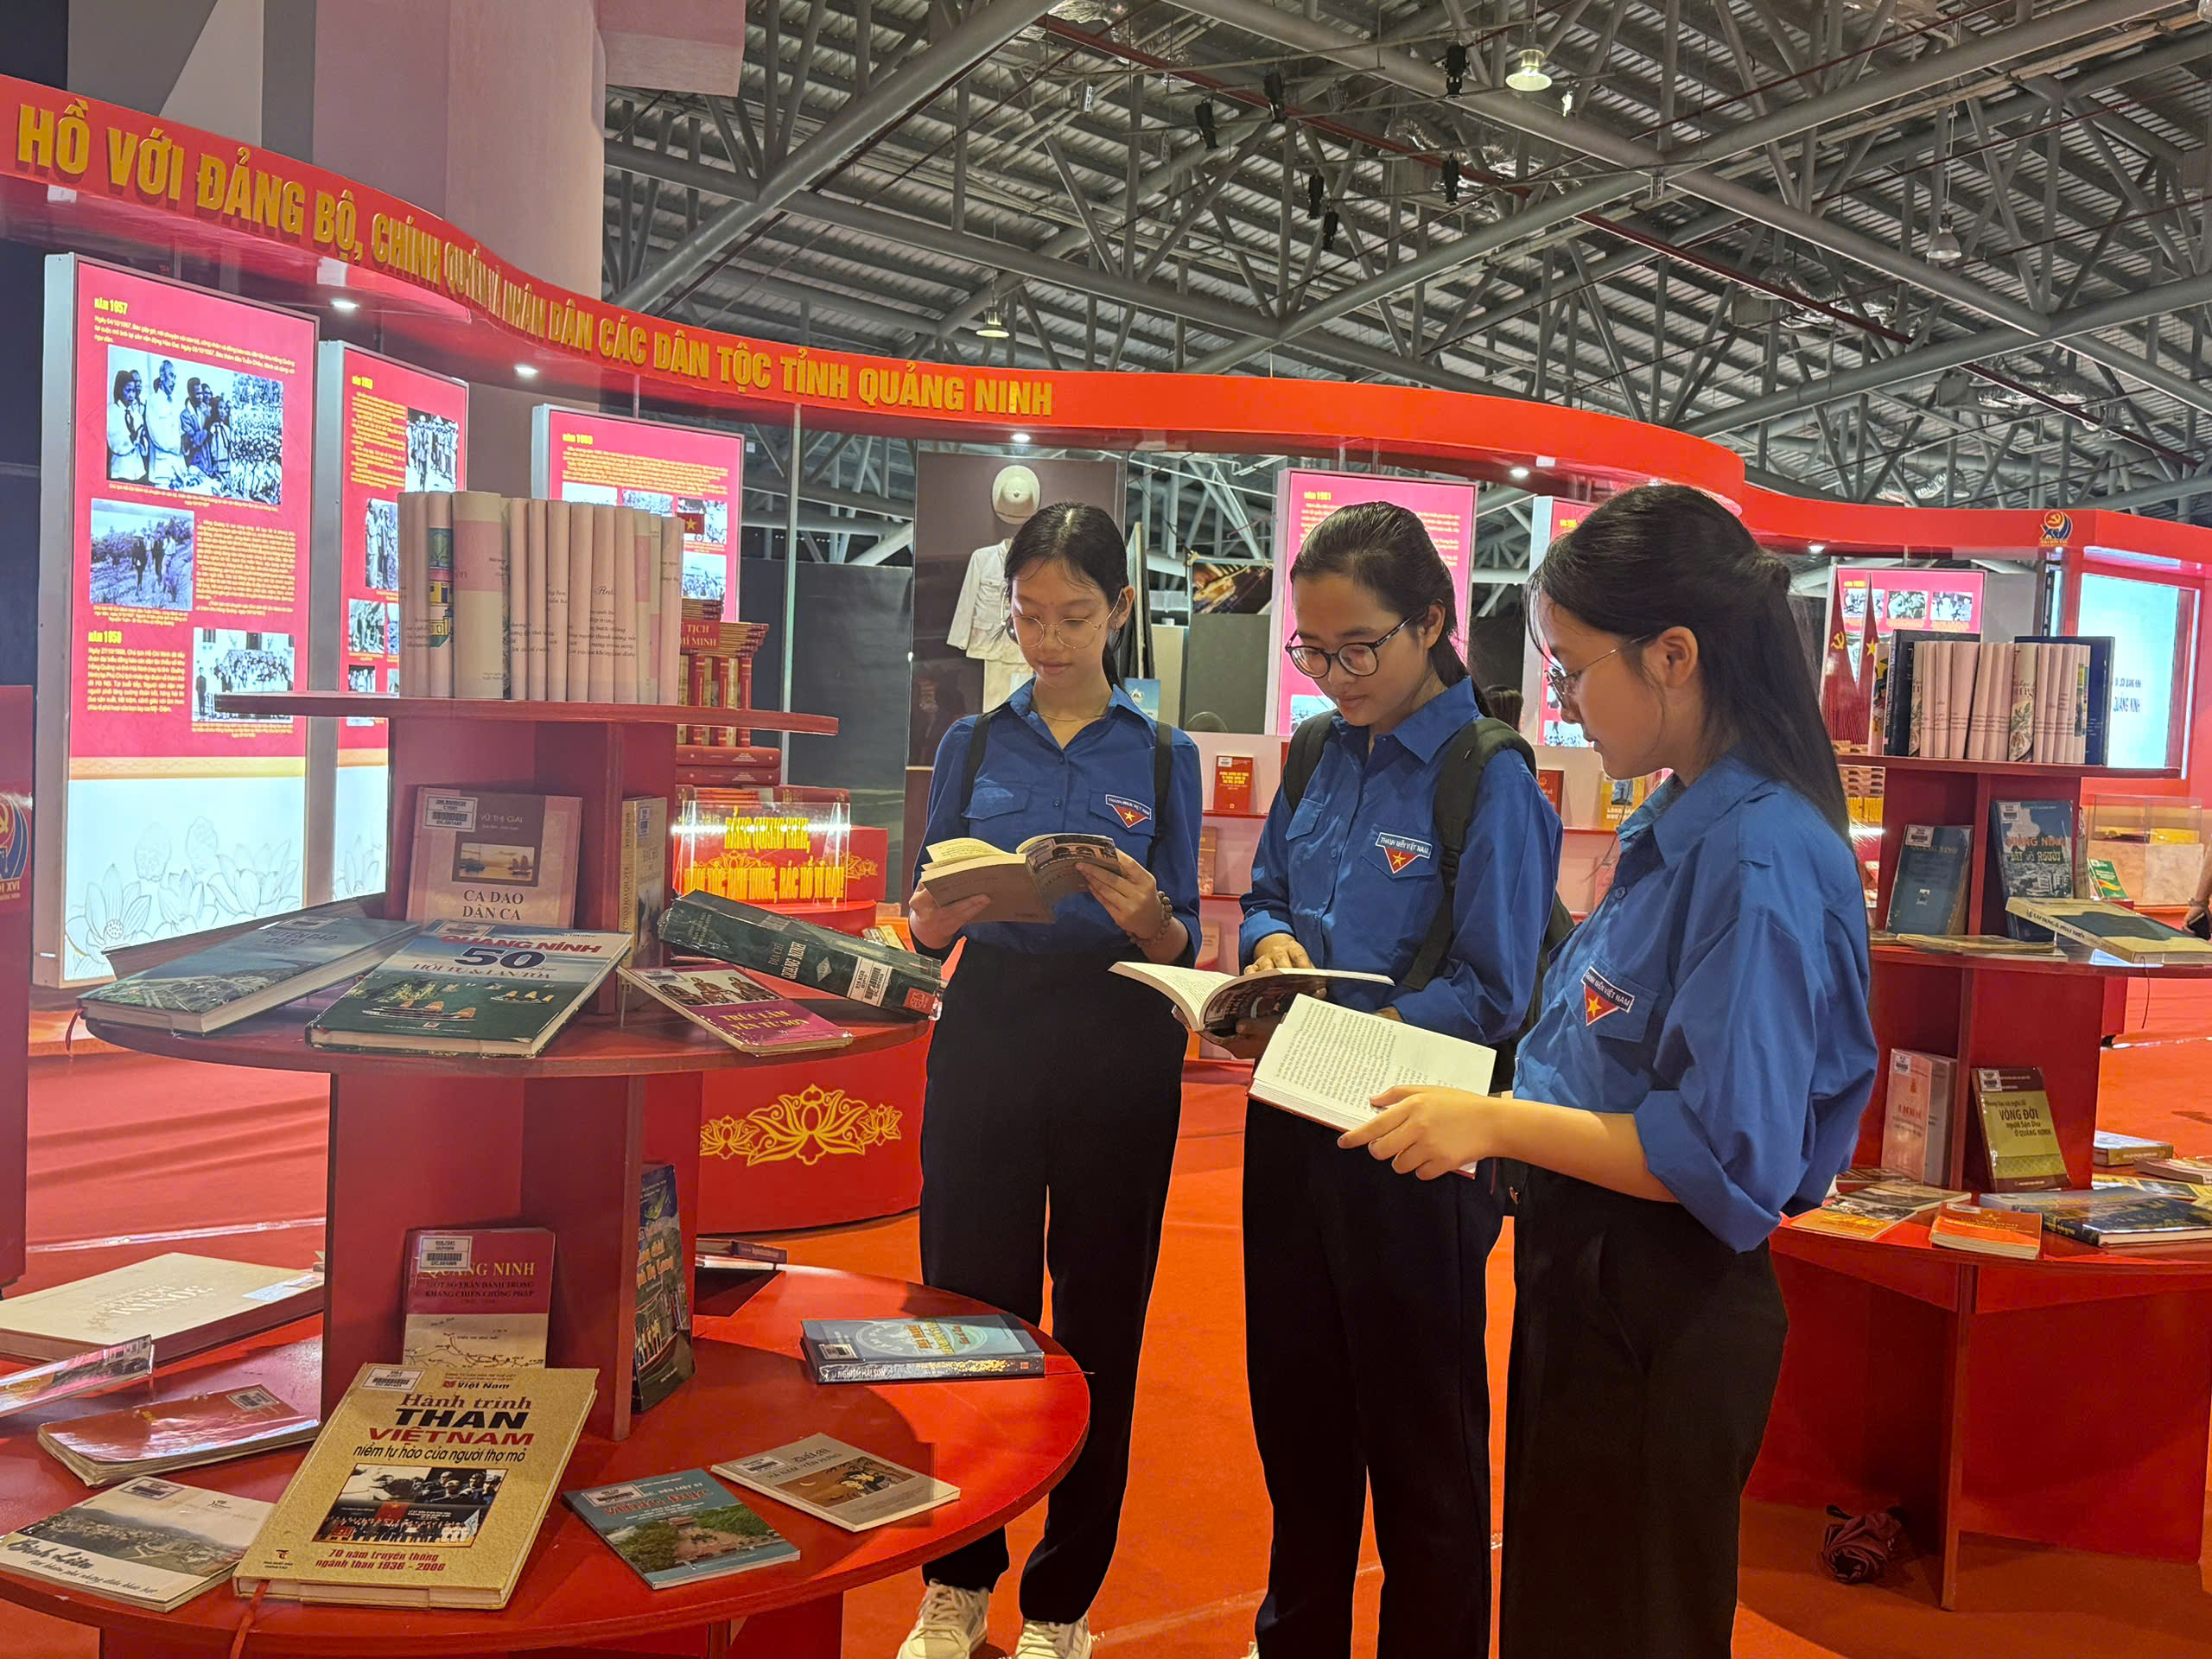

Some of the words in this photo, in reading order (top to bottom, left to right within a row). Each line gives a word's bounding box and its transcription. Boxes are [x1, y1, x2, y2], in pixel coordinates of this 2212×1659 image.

[17, 98, 90, 175] HỒ
[107, 127, 183, 201] VỚI
[196, 147, 304, 235] ĐẢNG
[314, 189, 363, 262] BỘ,
[372, 214, 442, 285] CHÍNH
[502, 283, 546, 339] NHÂN
[549, 298, 594, 352] DÂN
[599, 315, 647, 365] CÁC
[653, 328, 709, 378] DÂN
[716, 342, 772, 393] TỘC
[780, 347, 849, 398] TỈNH
[858, 360, 964, 410] QUẢNG
[975, 379, 1052, 416] NINH
[463, 889, 485, 904] CA
[488, 891, 524, 906] DAO
[462, 904, 495, 921] DÂN
[499, 907, 522, 921] CA
[454, 947, 547, 969] 50
[790, 941, 807, 961] NINH
[780, 957, 801, 980] QUẢNG
[1615, 995, 1630, 1007] NAM
[1999, 1107, 2022, 1121] VÒNG
[2023, 1106, 2040, 1120] ĐỜI
[493, 1262, 536, 1276] NINH
[401, 1394, 465, 1408] Hành
[473, 1396, 532, 1410] trình
[395, 1408, 529, 1429] THAN
[353, 1441, 383, 1458] niềm
[386, 1445, 399, 1460] tự
[399, 1445, 423, 1459] hào
[424, 1446, 448, 1460] của
[484, 1449, 507, 1465] thợ
[508, 1447, 528, 1462] mỏ
[328, 1548, 345, 1558] 70
[346, 1550, 369, 1560] năm
[315, 1558, 349, 1569] ngành
[350, 1560, 375, 1570] than
